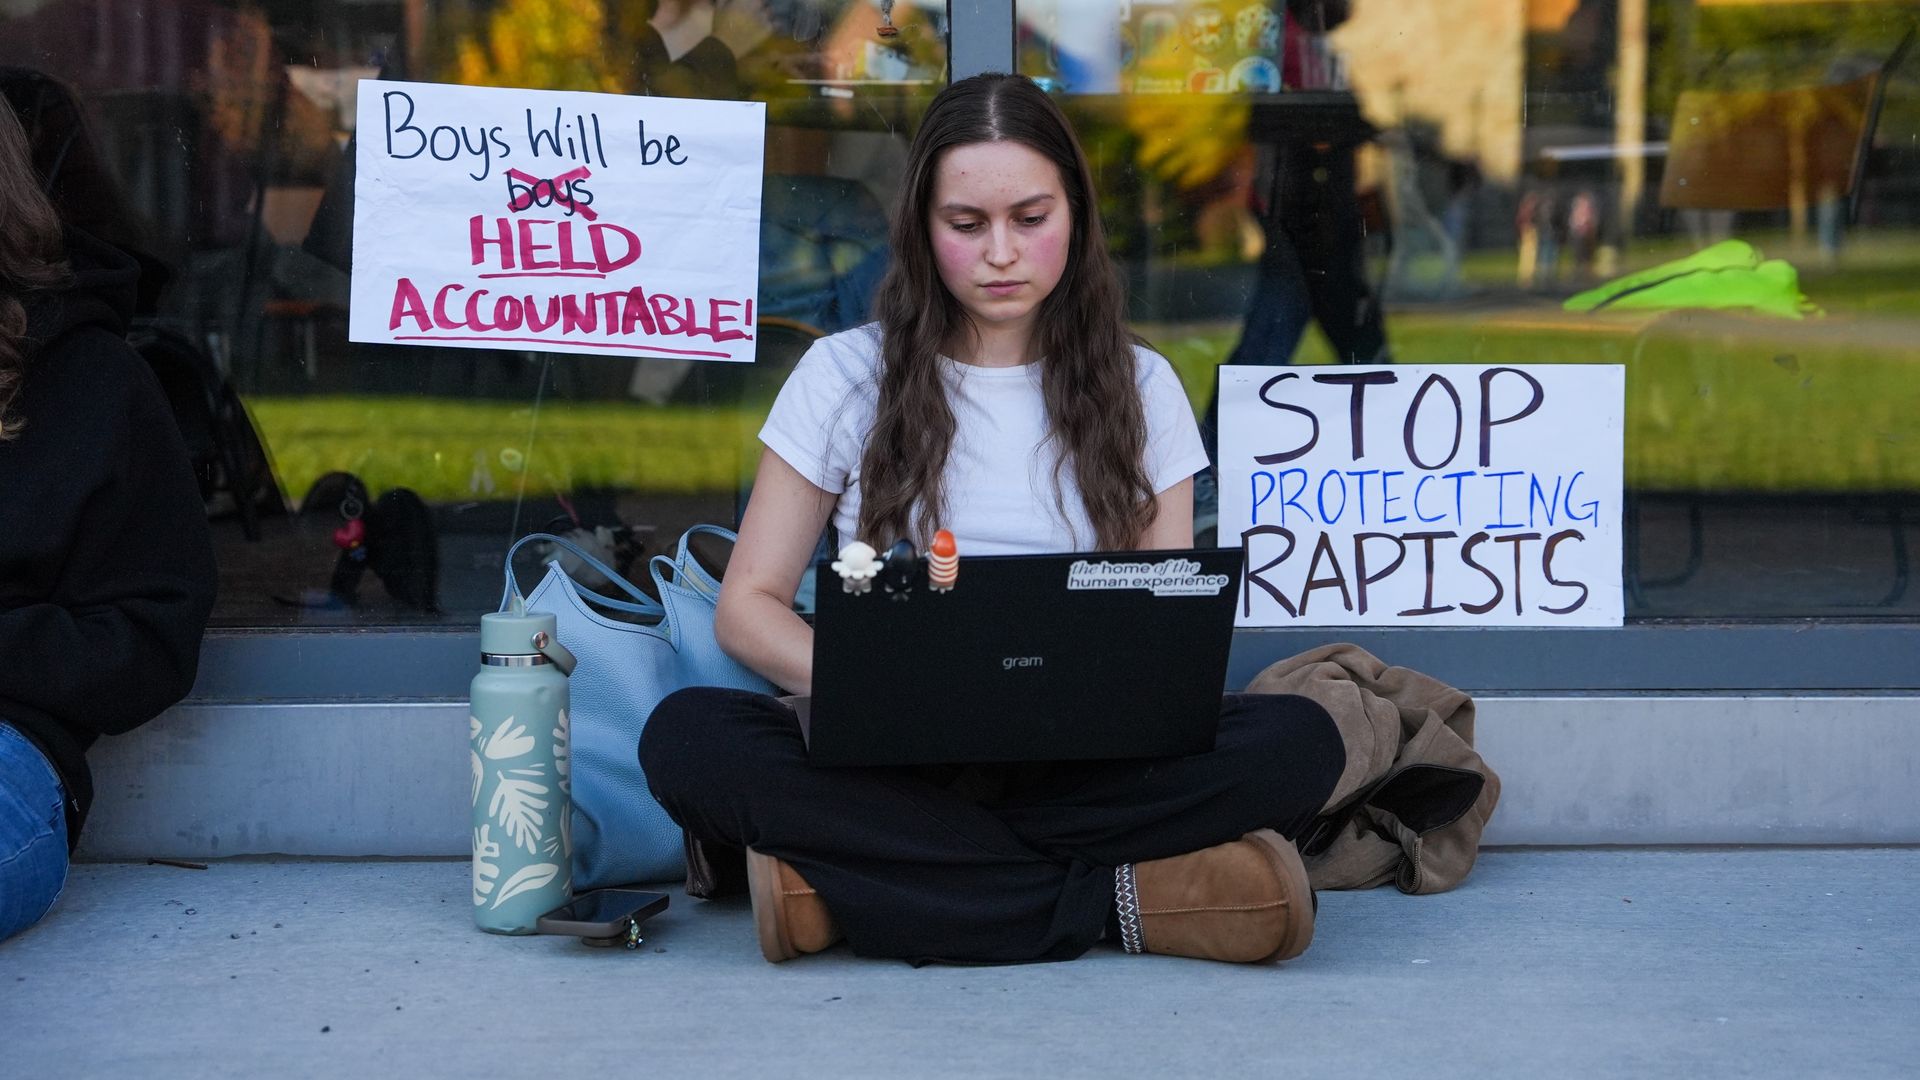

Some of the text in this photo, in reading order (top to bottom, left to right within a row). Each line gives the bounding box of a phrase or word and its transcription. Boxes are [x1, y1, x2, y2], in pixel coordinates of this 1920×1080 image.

[383, 91, 689, 181] Boys Will be
[505, 171, 595, 217] boys
[469, 214, 642, 273] HELD
[388, 277, 754, 343] ACCOUNTABLE!
[1253, 367, 1545, 470] STOP
[1250, 468, 1600, 530] PROTECTING
[1069, 575, 1228, 589] human experience
[1072, 559, 1200, 578] the home of the
[1240, 524, 1589, 618] RAPISTS
[1002, 656, 1043, 670] gram
